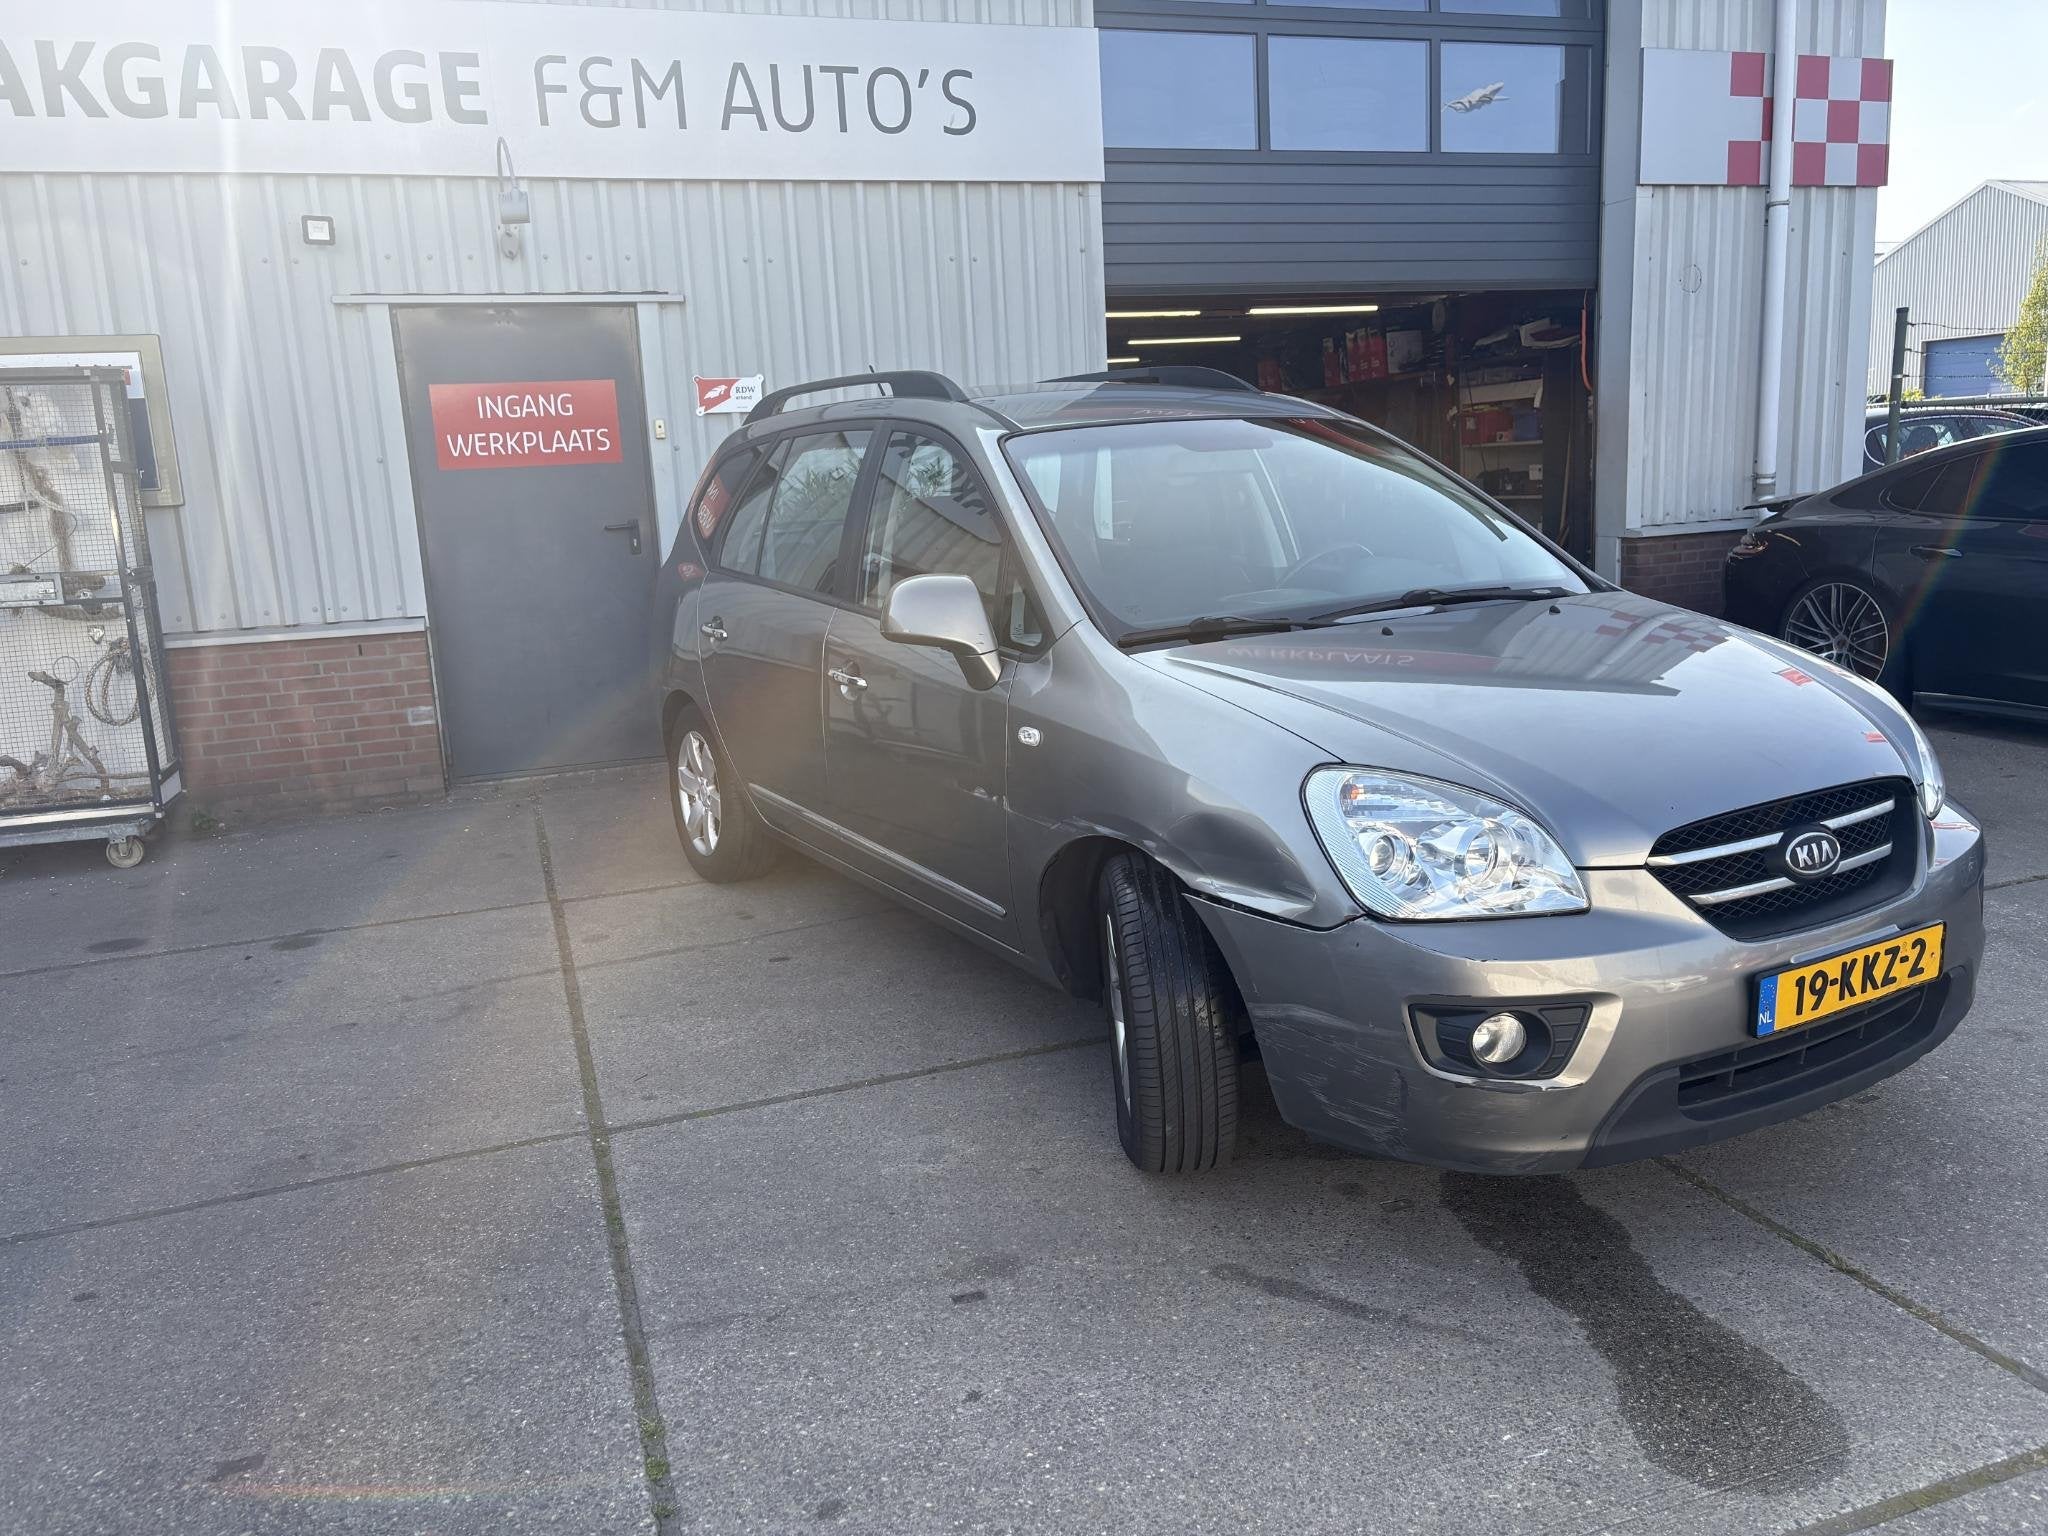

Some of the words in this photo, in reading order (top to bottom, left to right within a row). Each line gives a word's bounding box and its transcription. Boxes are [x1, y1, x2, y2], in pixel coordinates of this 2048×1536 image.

[533, 55, 688, 130] F&M
[720, 62, 977, 137] AUTO'S
[735, 385, 756, 394] RDW
[477, 393, 574, 419] INGANG
[446, 428, 611, 457] WERKPLAATS
[1795, 839, 1834, 869] KIA
[1795, 937, 1928, 1016] 19-KKZ-2
[1758, 1010, 1773, 1025] NL
